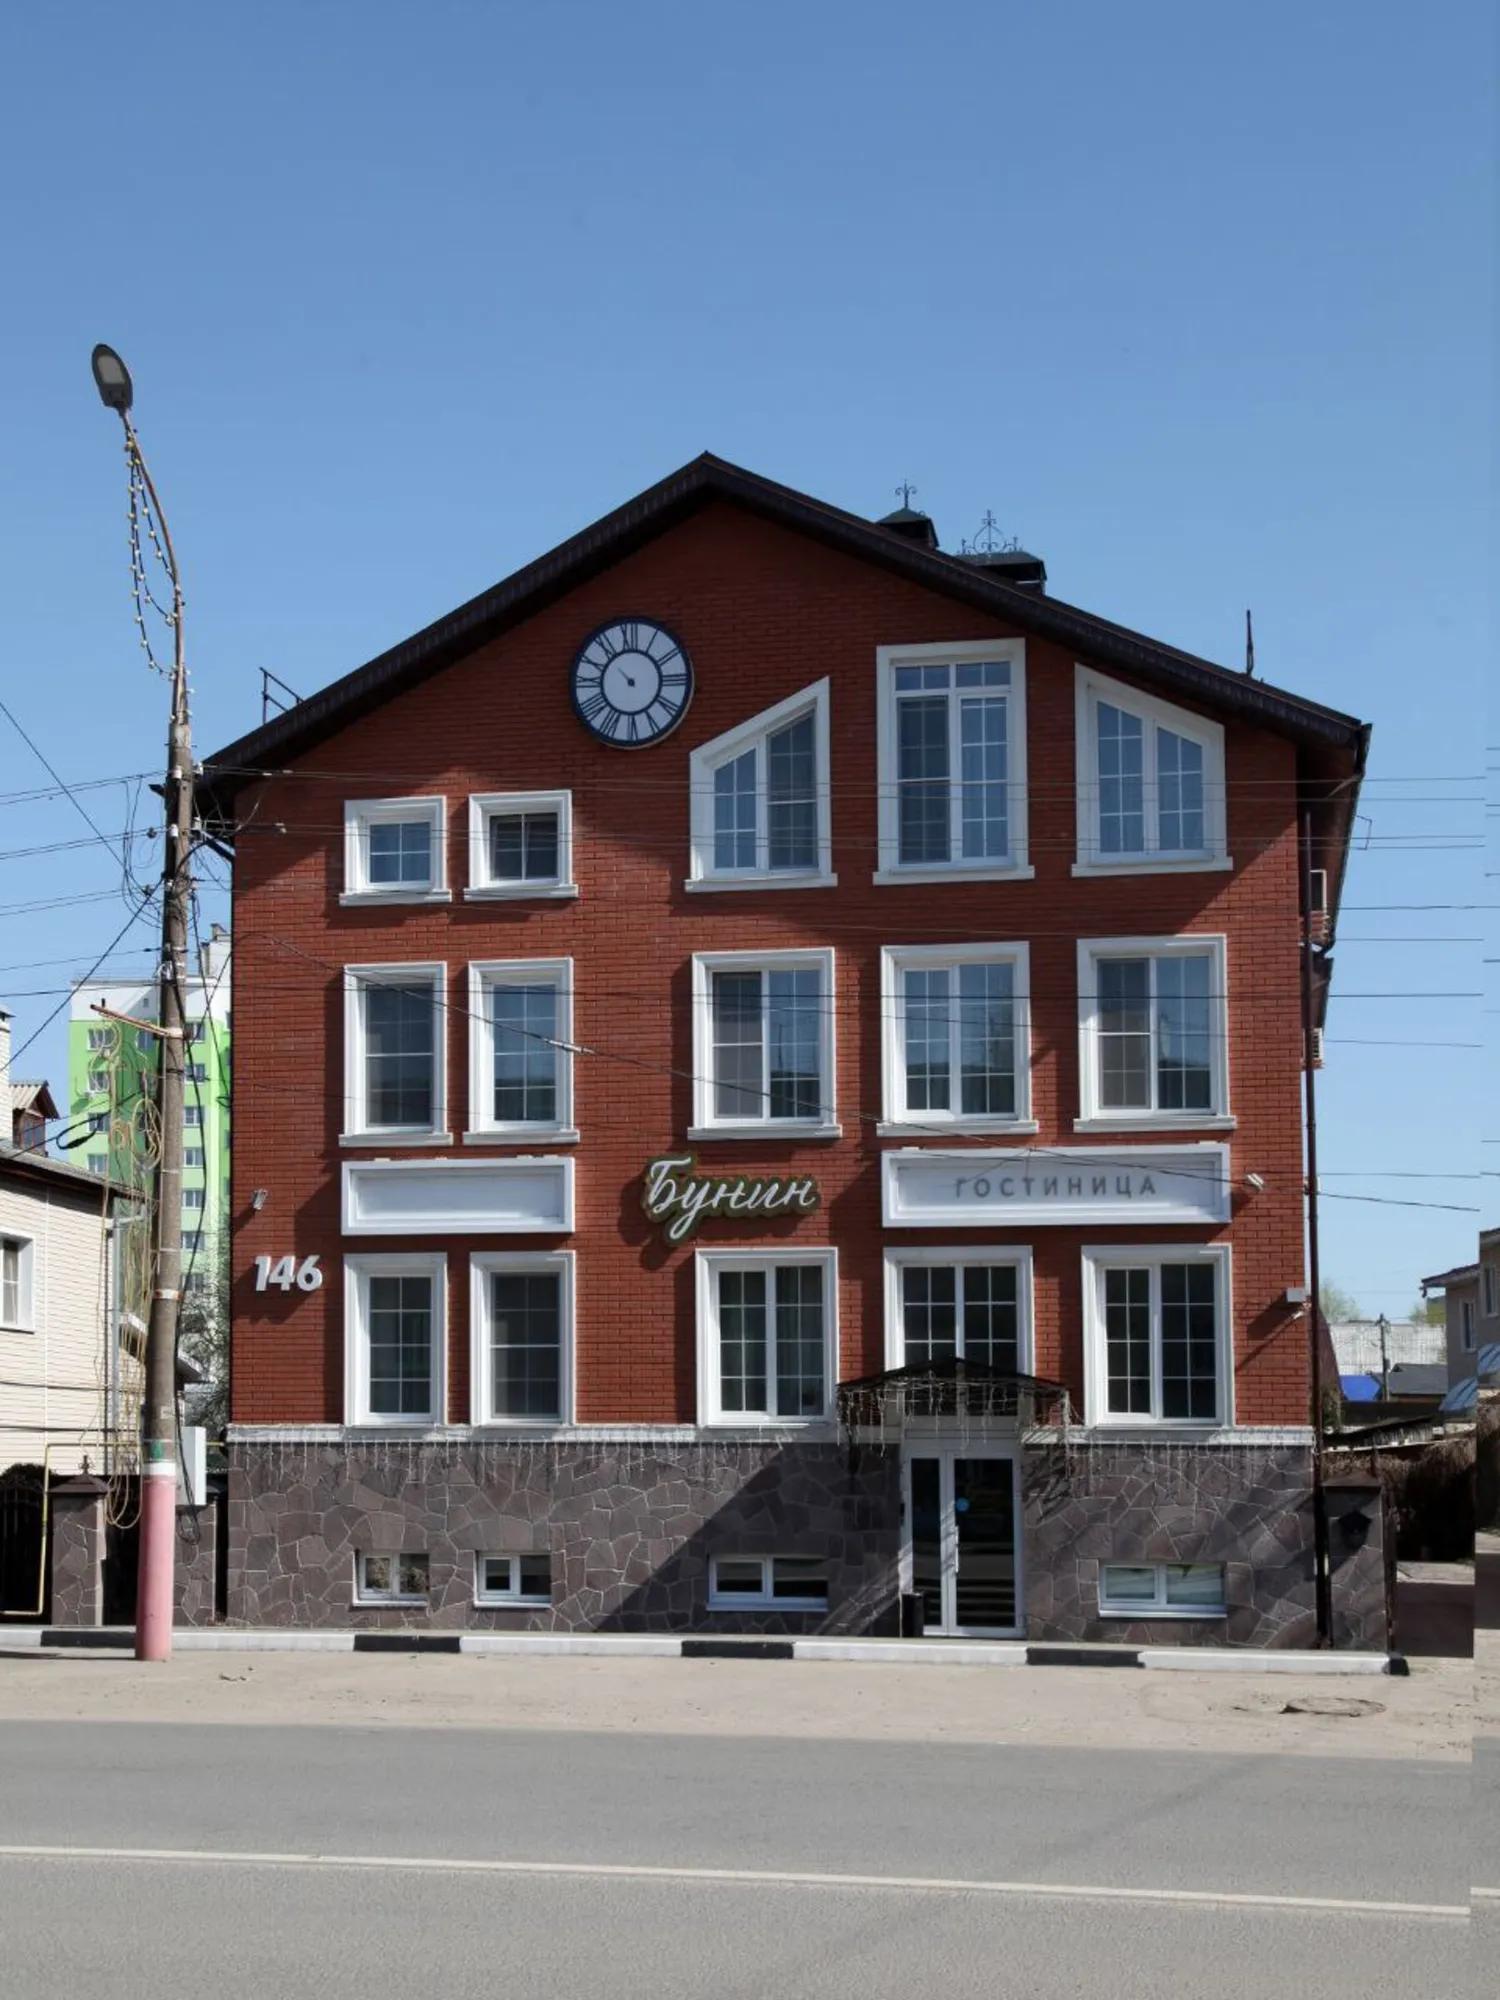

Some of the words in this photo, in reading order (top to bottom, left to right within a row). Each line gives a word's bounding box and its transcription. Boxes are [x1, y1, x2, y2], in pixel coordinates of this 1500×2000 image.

[648, 1156, 817, 1240] Бунин
[955, 1175, 1156, 1198] ГОСТИНИЦА
[254, 1254, 323, 1291] 146
